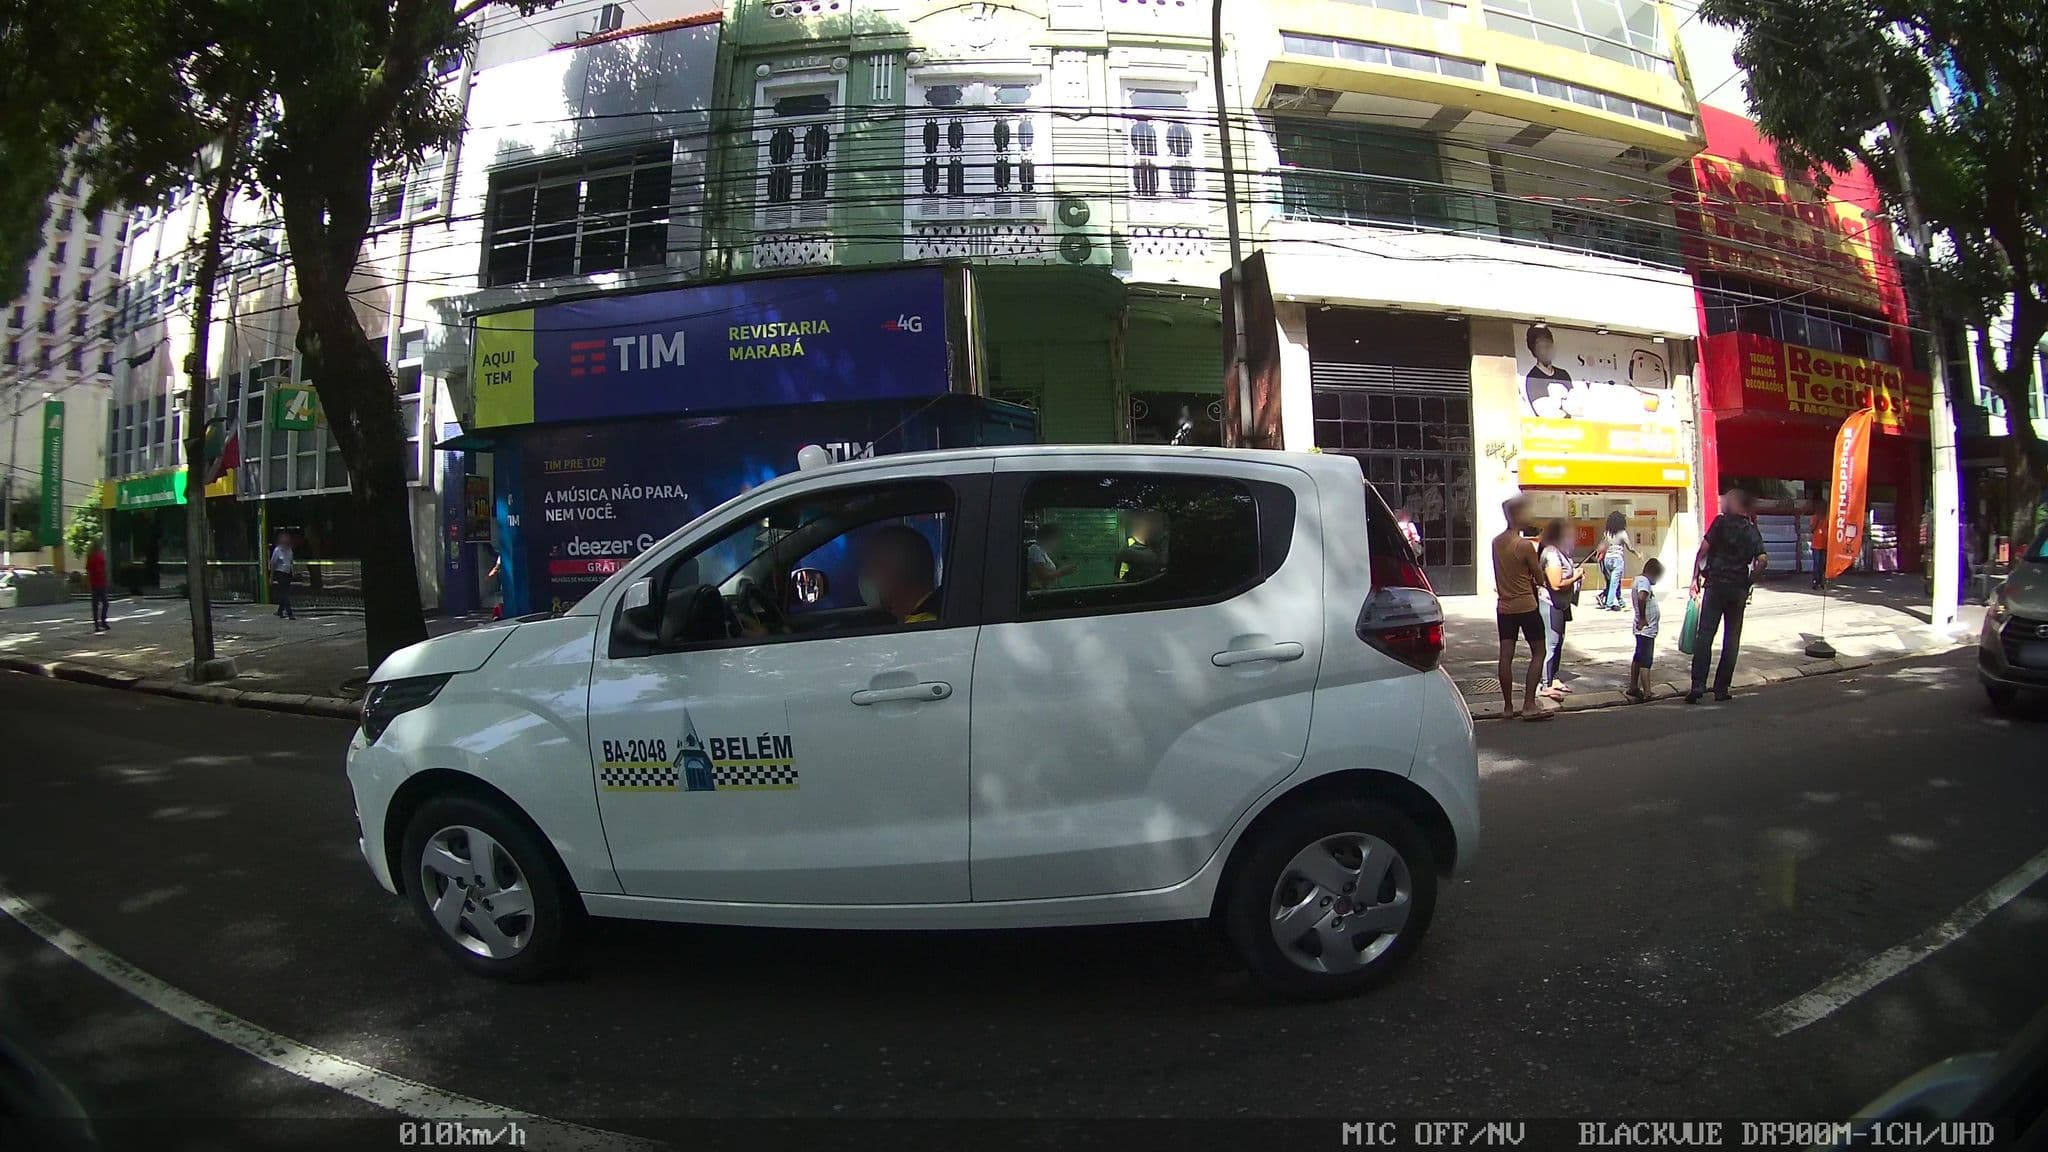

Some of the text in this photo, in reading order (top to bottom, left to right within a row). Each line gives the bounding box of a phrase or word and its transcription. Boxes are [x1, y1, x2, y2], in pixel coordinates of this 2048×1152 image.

[729, 319, 831, 341] REVISTARIA
[897, 314, 923, 333] 4G
[483, 350, 515, 368] AQUI
[613, 331, 686, 371] TIM
[729, 338, 805, 361] MARABÁ
[485, 370, 512, 386] TEM
[1788, 347, 1903, 390] Renata
[1790, 374, 1904, 414] Tecidos
[826, 441, 875, 463] TIM
[544, 460, 562, 471] TIM
[586, 457, 607, 468] TOP
[545, 483, 688, 504] A MÚSICA NÃO PARA,
[545, 503, 617, 522] NEM VOCÊ.
[567, 533, 662, 556] deezer G
[602, 731, 794, 763] BA-2048 BELÉM
